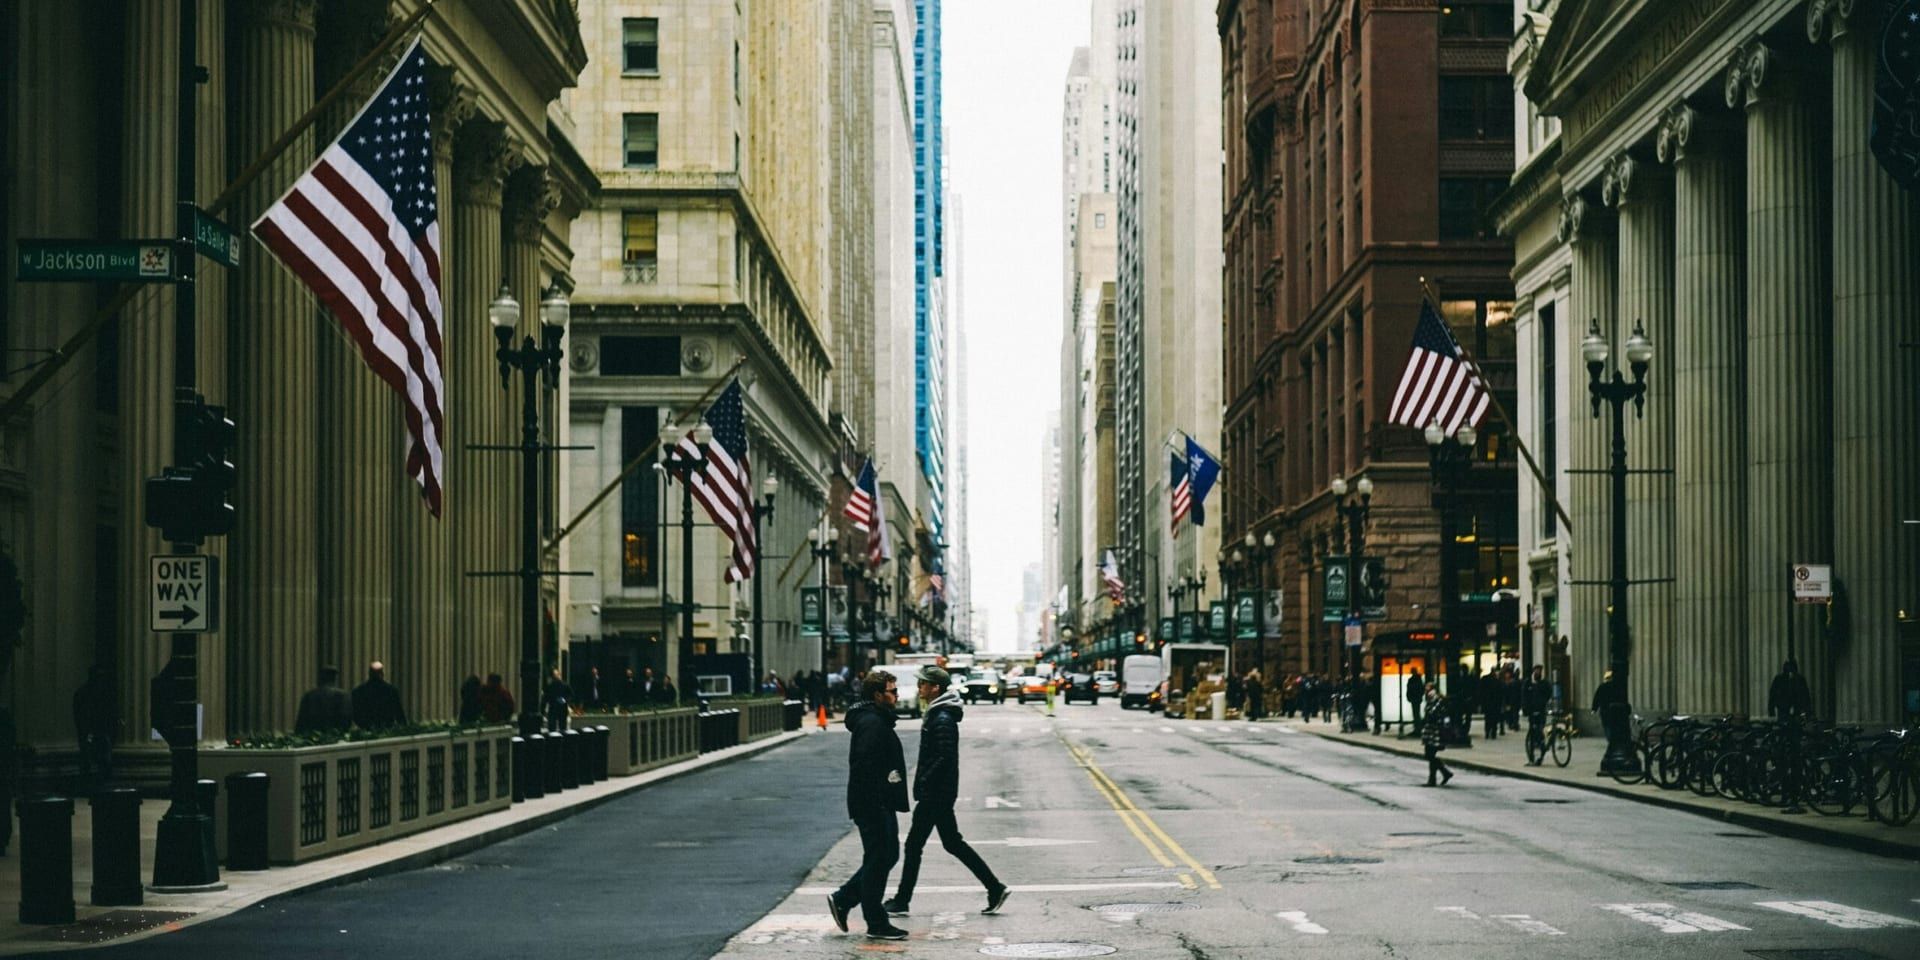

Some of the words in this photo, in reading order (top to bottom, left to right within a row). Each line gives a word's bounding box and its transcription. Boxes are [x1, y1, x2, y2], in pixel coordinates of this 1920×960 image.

[35, 247, 105, 270] Jackson
[110, 255, 135, 267] Blvd
[158, 561, 202, 580] ONE
[157, 582, 202, 601] WAY
